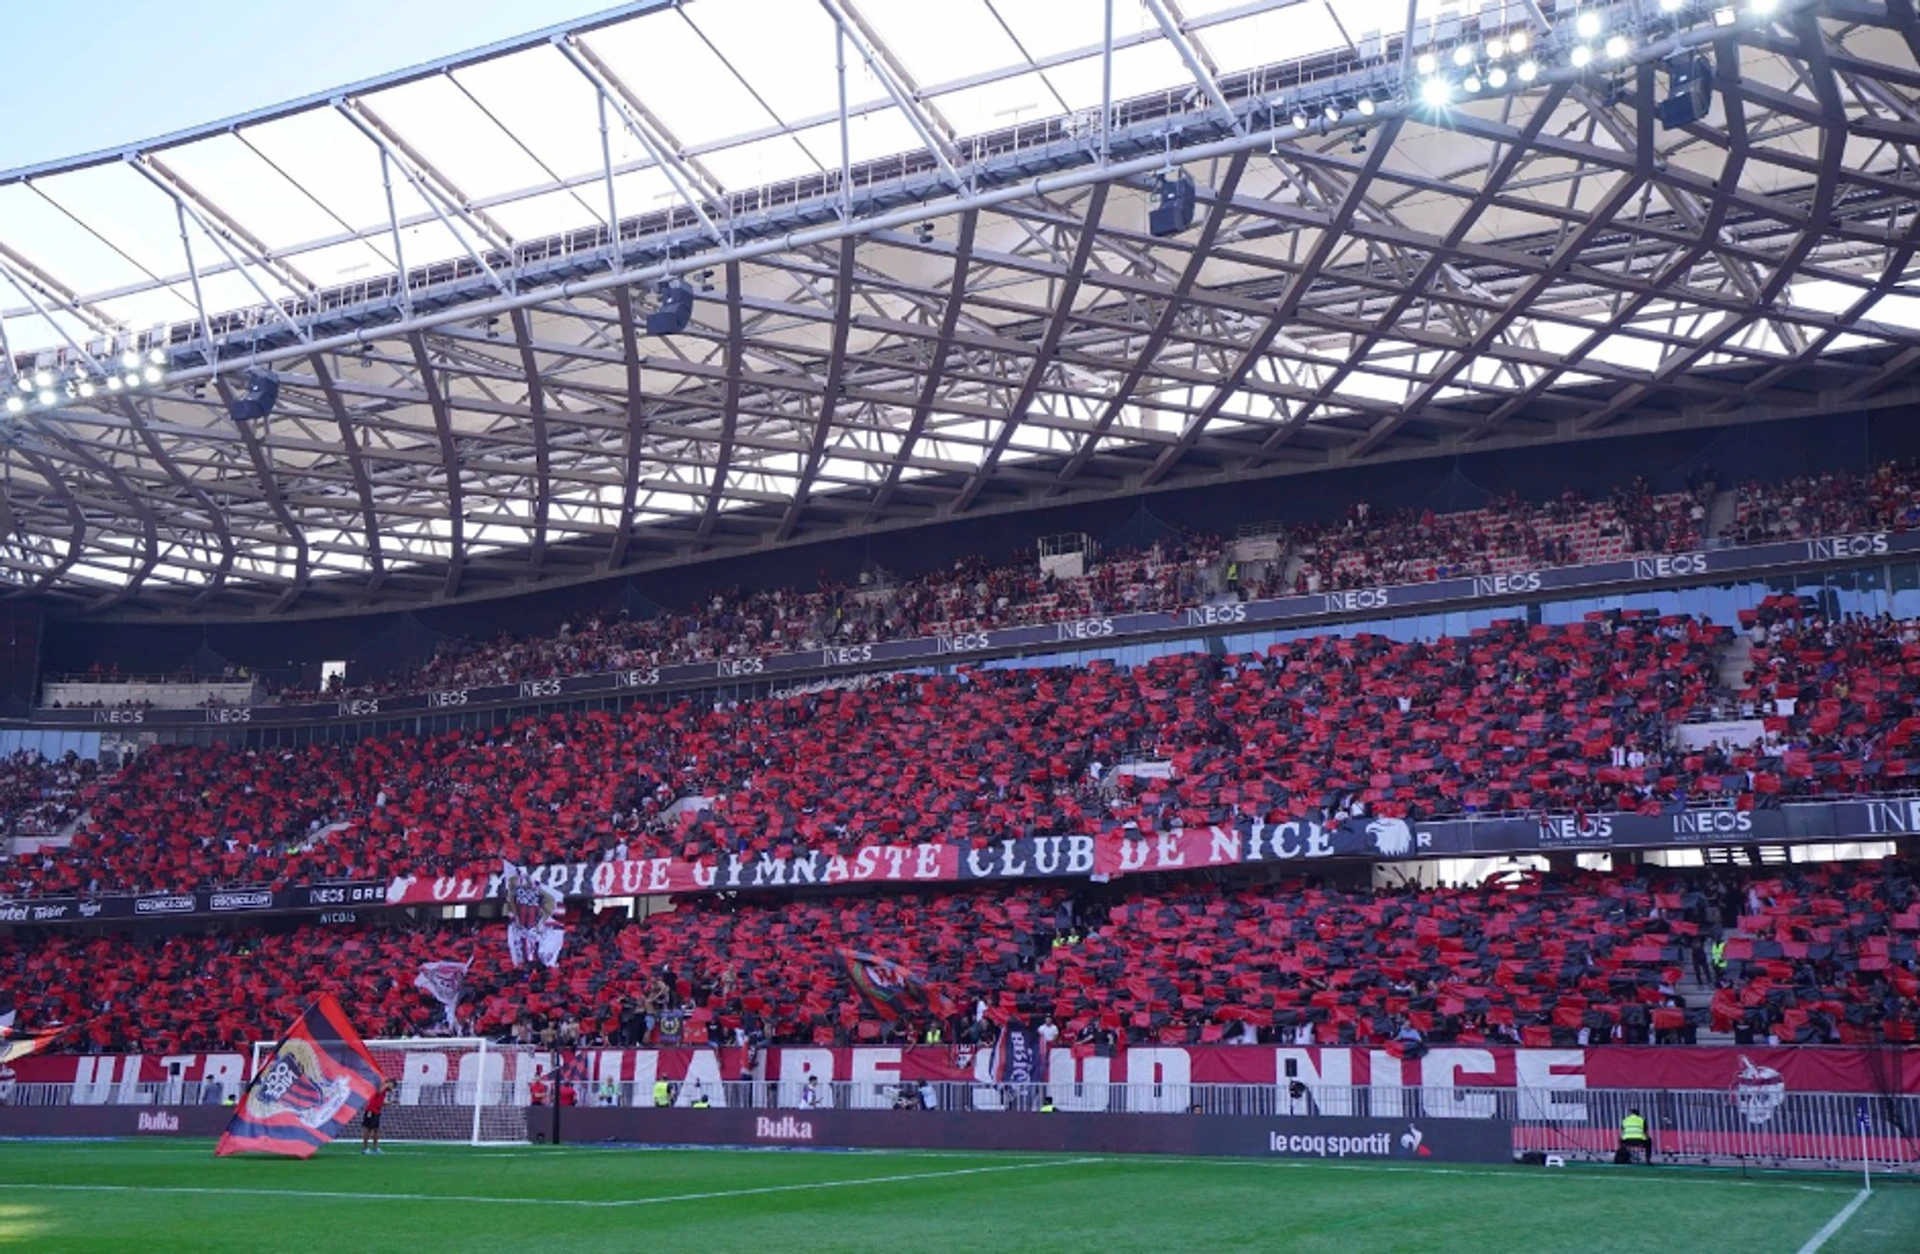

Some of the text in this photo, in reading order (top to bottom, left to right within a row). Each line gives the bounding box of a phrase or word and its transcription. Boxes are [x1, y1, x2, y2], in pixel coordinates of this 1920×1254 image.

[1808, 533, 1889, 560] INEOS
[1633, 554, 1708, 578] INEOS
[1473, 573, 1541, 597] INEOS
[1325, 589, 1388, 612] INEOS
[1187, 604, 1247, 625] INEOS
[1057, 619, 1114, 639] INEOS
[937, 633, 990, 653] INEOS
[823, 645, 872, 666] INEOS
[717, 658, 764, 677] INEOS
[520, 680, 562, 698] INEOS
[615, 669, 660, 689] INEOS
[338, 700, 379, 716] INEOS
[428, 691, 468, 707] INEOS
[93, 711, 144, 723] INEOS
[205, 709, 251, 722] INEOS
[1538, 817, 1613, 839] INEOS
[1673, 811, 1752, 833] INEOS
[966, 836, 1095, 877] CLUB
[1119, 828, 1185, 870] DE
[1210, 817, 1334, 861] NICE
[310, 889, 344, 904] INEOS
[69, 1055, 246, 1105] ULTR
[1276, 1048, 1587, 1121] NICE
[756, 1116, 813, 1139] Bułka
[1270, 1131, 1391, 1157] le coq sportif
